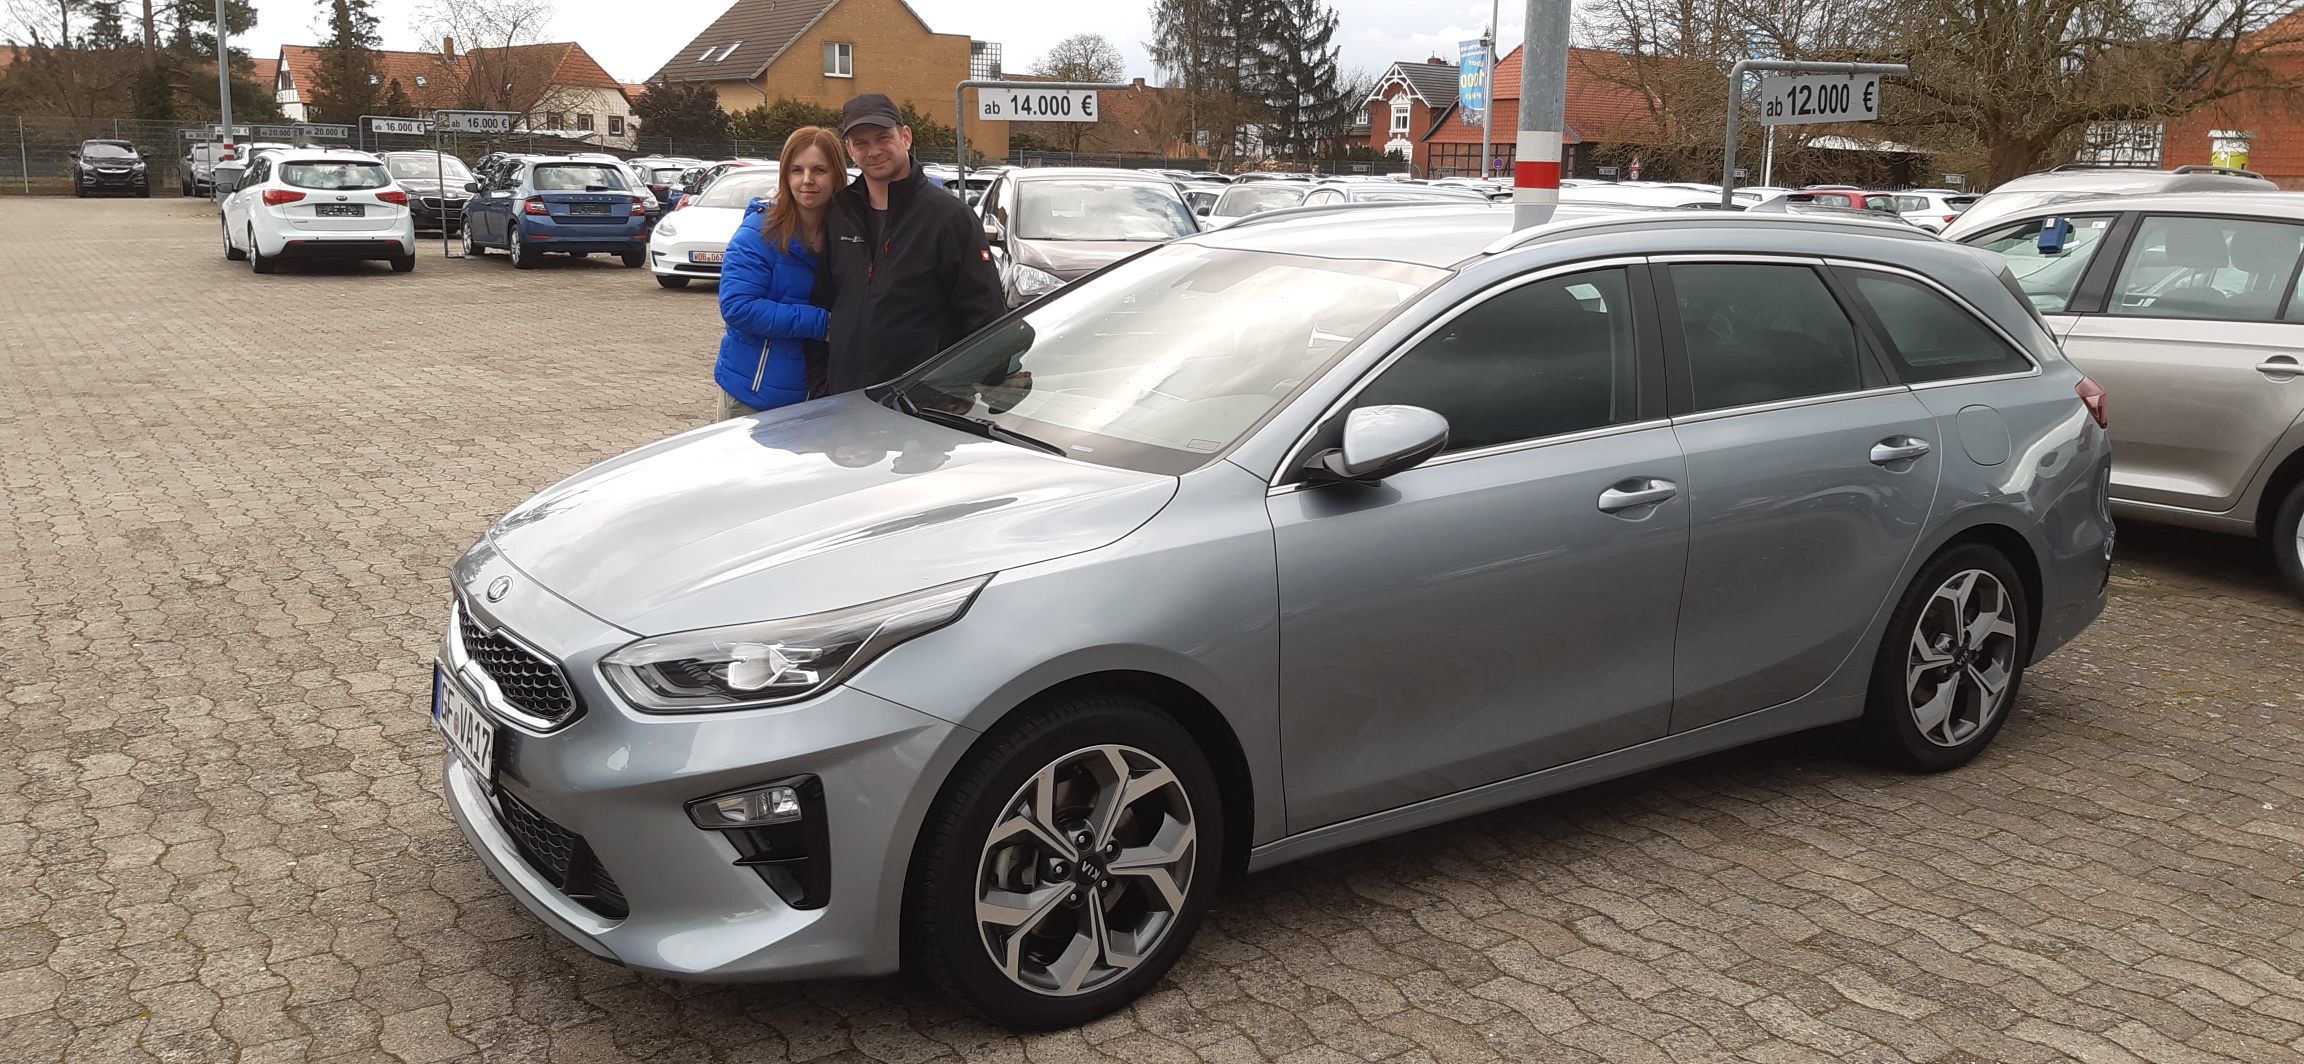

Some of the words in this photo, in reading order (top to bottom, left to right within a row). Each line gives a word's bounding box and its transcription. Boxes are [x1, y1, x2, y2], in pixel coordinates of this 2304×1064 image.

[984, 101, 1001, 115] ab
[1010, 94, 1071, 116] 14.000
[1081, 94, 1093, 116] €
[1766, 96, 1783, 117] ab
[1787, 83, 1850, 116] 12.000
[1863, 81, 1875, 112] €
[385, 122, 413, 132] 16.000
[417, 123, 423, 132] €
[451, 119, 460, 128] ab
[467, 117, 498, 129] 16.000
[501, 118, 508, 129] €
[268, 129, 291, 137] 20.000
[314, 128, 338, 136] 20.000
[341, 128, 346, 136] €
[711, 253, 724, 261] 067
[441, 681, 455, 725] GF
[1081, 860, 1101, 881] KIA
